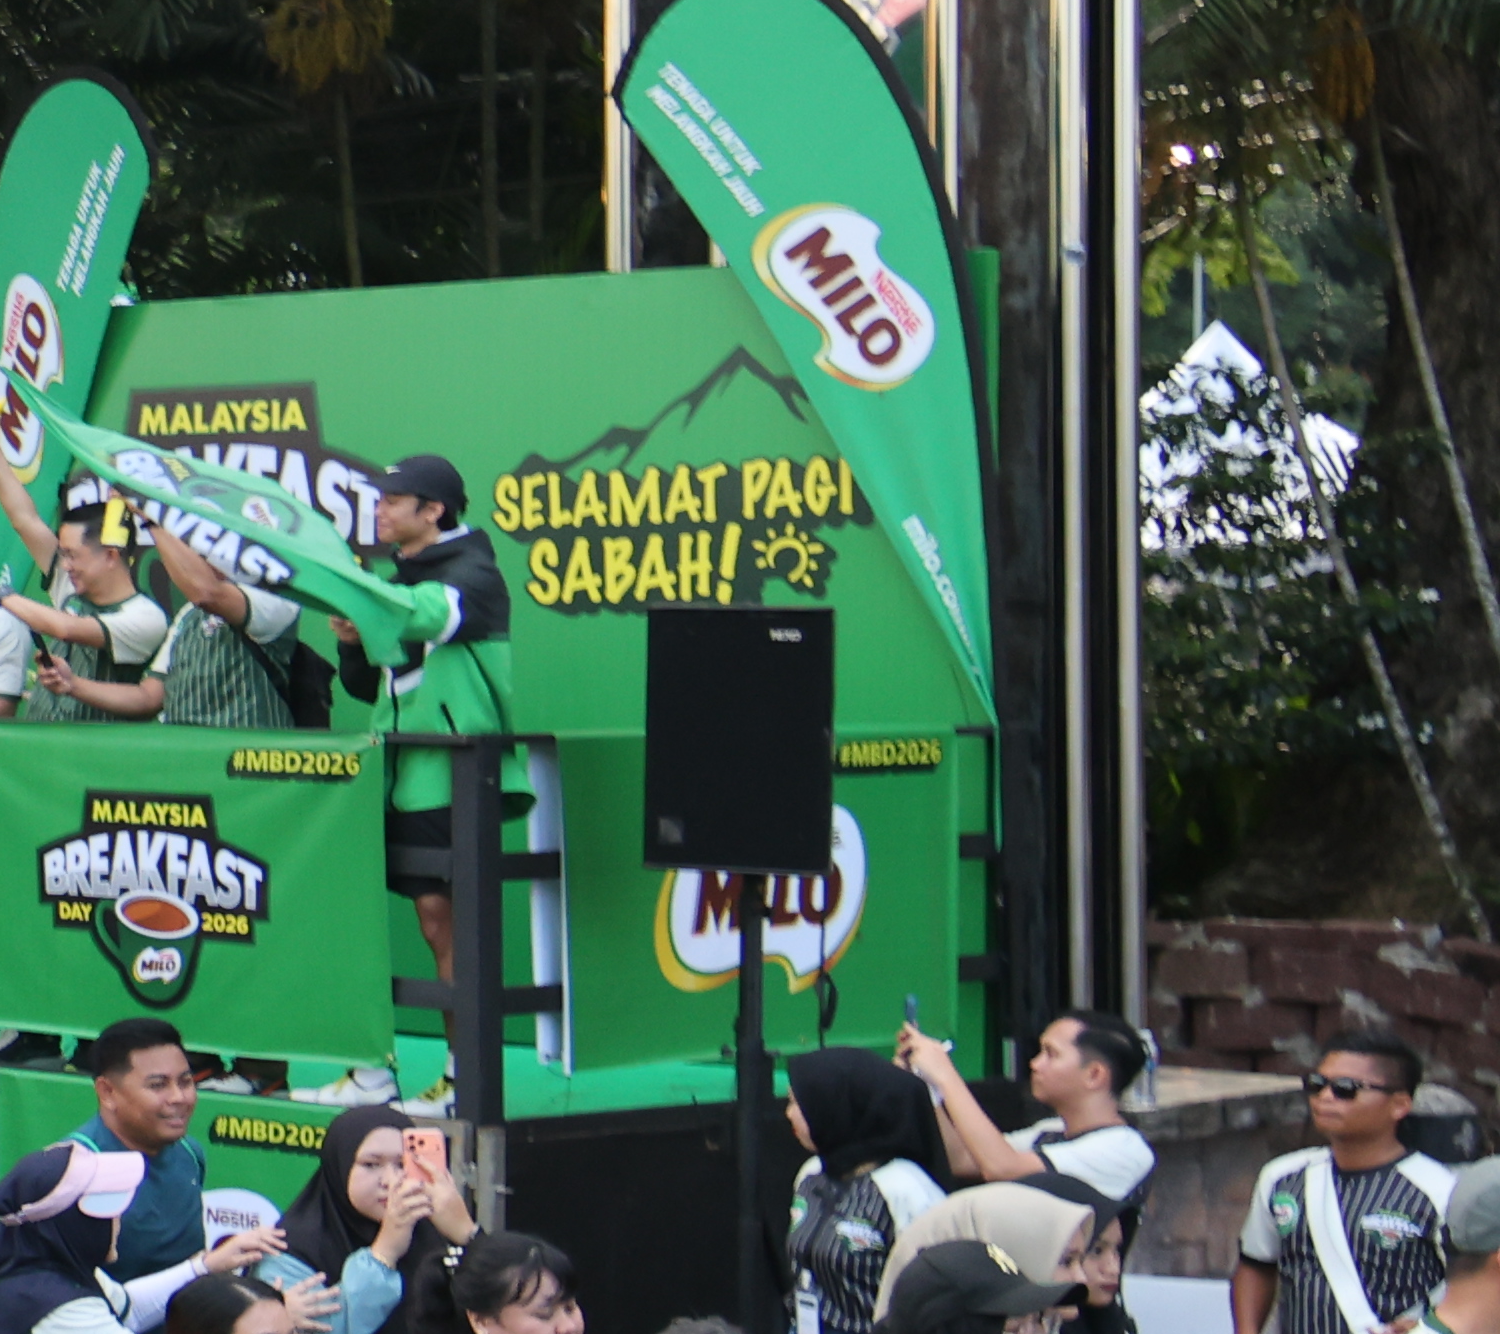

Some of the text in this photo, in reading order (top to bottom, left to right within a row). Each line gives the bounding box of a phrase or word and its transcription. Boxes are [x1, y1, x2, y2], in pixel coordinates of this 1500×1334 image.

[103, 143, 126, 194] JAUH
[55, 160, 102, 293] TENAGA UNTUK
[784, 227, 902, 366] MILO
[138, 398, 309, 436] MALAYSIA
[492, 455, 854, 532] SELAMAT PAGI
[526, 521, 743, 606] SABAH!
[231, 748, 361, 777] #MBD2026
[839, 738, 943, 768] #MBD2026
[91, 799, 208, 828] MALAYSIA
[43, 829, 263, 911] BREAKFAST
[58, 900, 249, 935] DAY 2026
[691, 863, 843, 938] MLO
[214, 1115, 328, 1150] #MBD202
[206, 1207, 261, 1230] Nestlé
